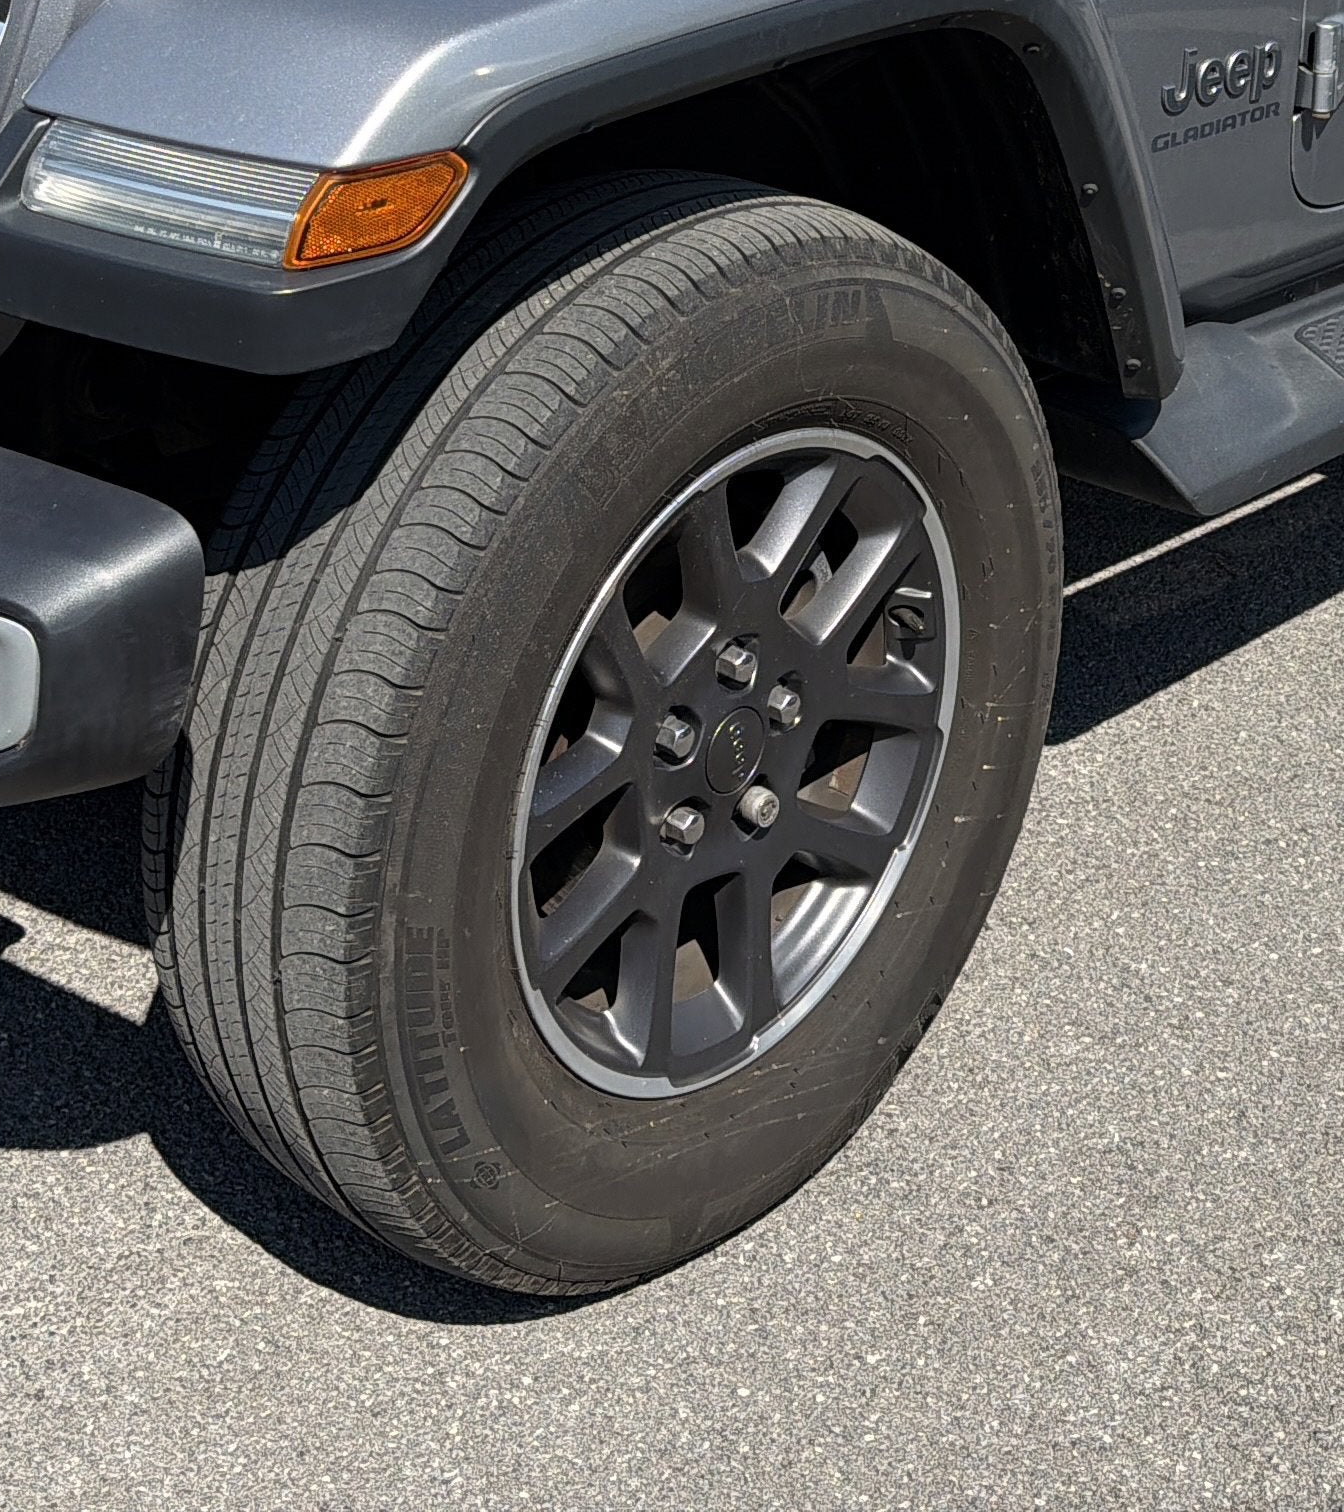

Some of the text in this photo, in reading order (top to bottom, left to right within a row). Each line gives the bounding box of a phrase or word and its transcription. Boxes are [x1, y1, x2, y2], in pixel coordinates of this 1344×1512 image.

[1161, 41, 1282, 117] Jeep
[1150, 101, 1281, 153] GLADIATOR
[405, 926, 472, 1156] LATITUDE
